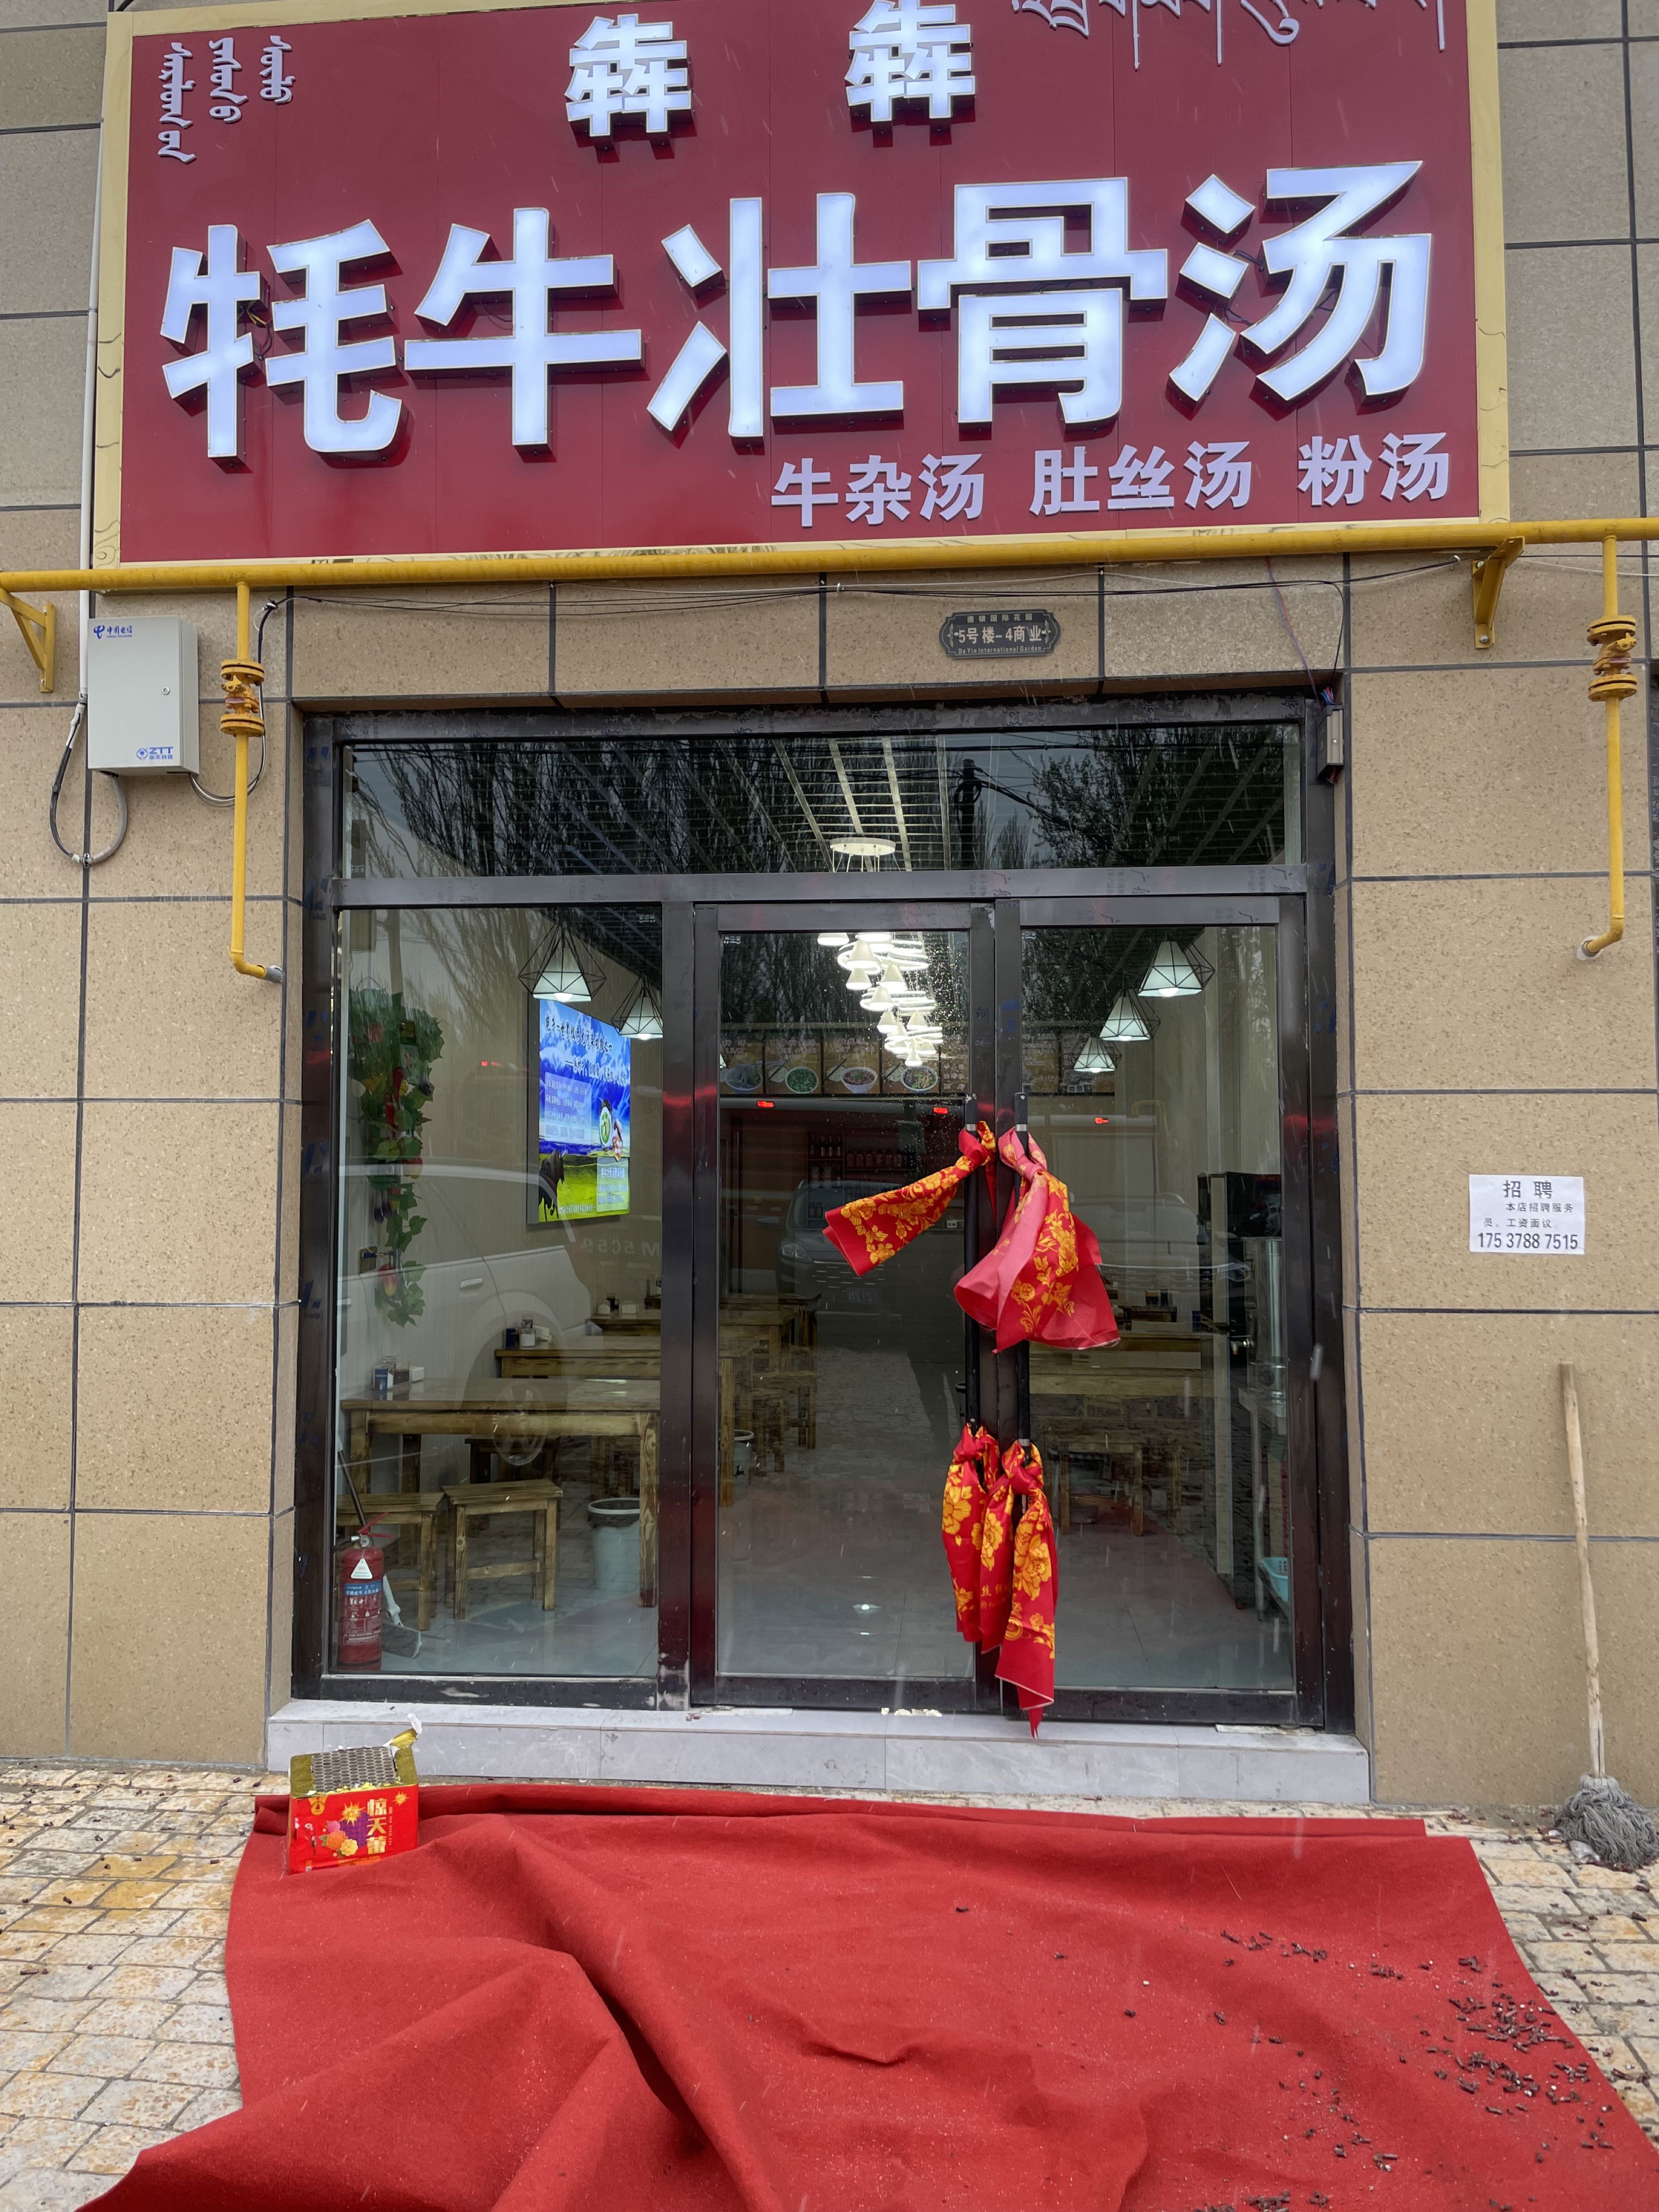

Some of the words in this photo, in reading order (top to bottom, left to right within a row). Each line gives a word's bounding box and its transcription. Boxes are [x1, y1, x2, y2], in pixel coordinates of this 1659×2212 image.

[160, 160, 1432, 458] 牦牛壮骨汤
[771, 453, 984, 528] 牛杂汤
[1030, 440, 1252, 516] 肚丝汤
[1297, 432, 1450, 506] 粉汤
[107, 625, 132, 634] 中国电信
[1503, 1180, 1553, 1199] 招聘
[1506, 1202, 1574, 1213] 本店招聘服务
[1478, 1232, 1502, 1248] 175
[1506, 1232, 1540, 1249] 3788
[1544, 1233, 1578, 1250] 7515
